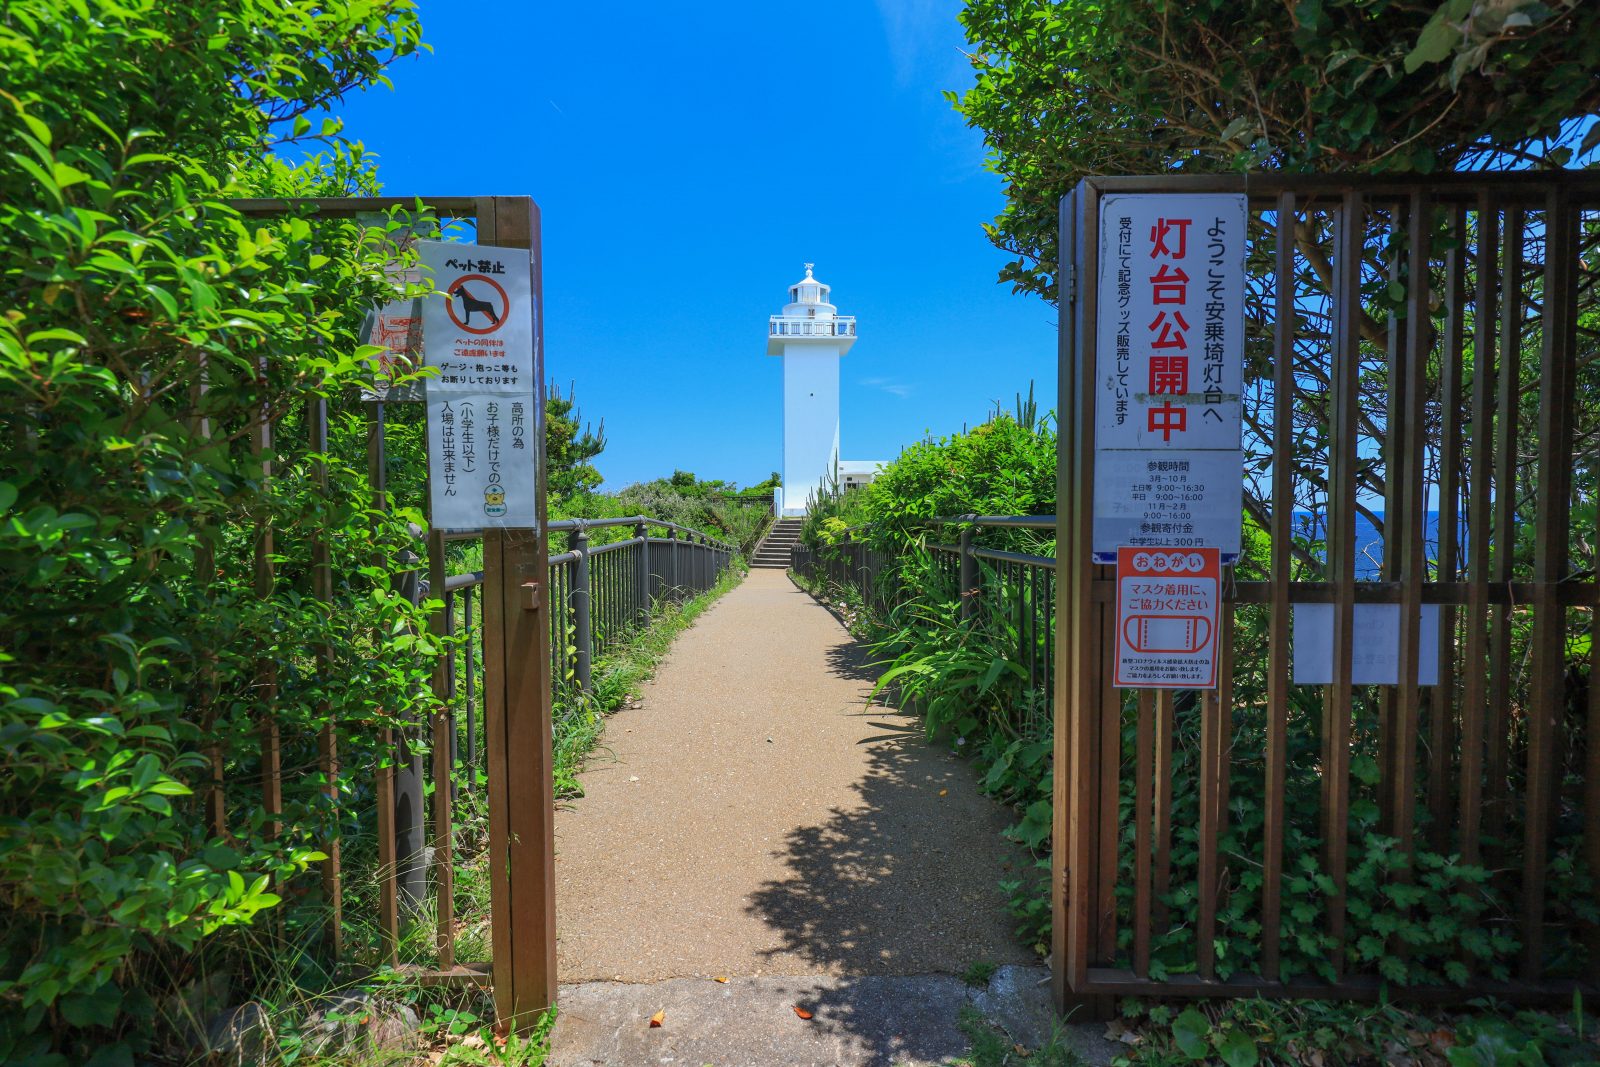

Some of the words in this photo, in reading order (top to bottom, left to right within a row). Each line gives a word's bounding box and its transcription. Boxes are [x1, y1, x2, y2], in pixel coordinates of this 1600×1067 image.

[445, 259, 505, 274] ペット禁止
[1115, 216, 1133, 426] 受付にて記念グッズ販売しています
[1147, 217, 1192, 442] 灯台公開中
[455, 338, 504, 347] ペットの同伴は
[441, 375, 518, 385] お断りしております
[511, 401, 525, 450] 高所の為
[460, 401, 476, 473] （小学生以下）
[486, 401, 500, 484] お子様だけでの
[441, 401, 457, 497] 入場は出来ません
[1147, 461, 1190, 472] 参観時間
[1132, 493, 1146, 501] 平日
[1140, 523, 1193, 534] 参観寄付金
[1136, 556, 1201, 568] おねがい
[1128, 598, 1208, 611] ご協力ください
